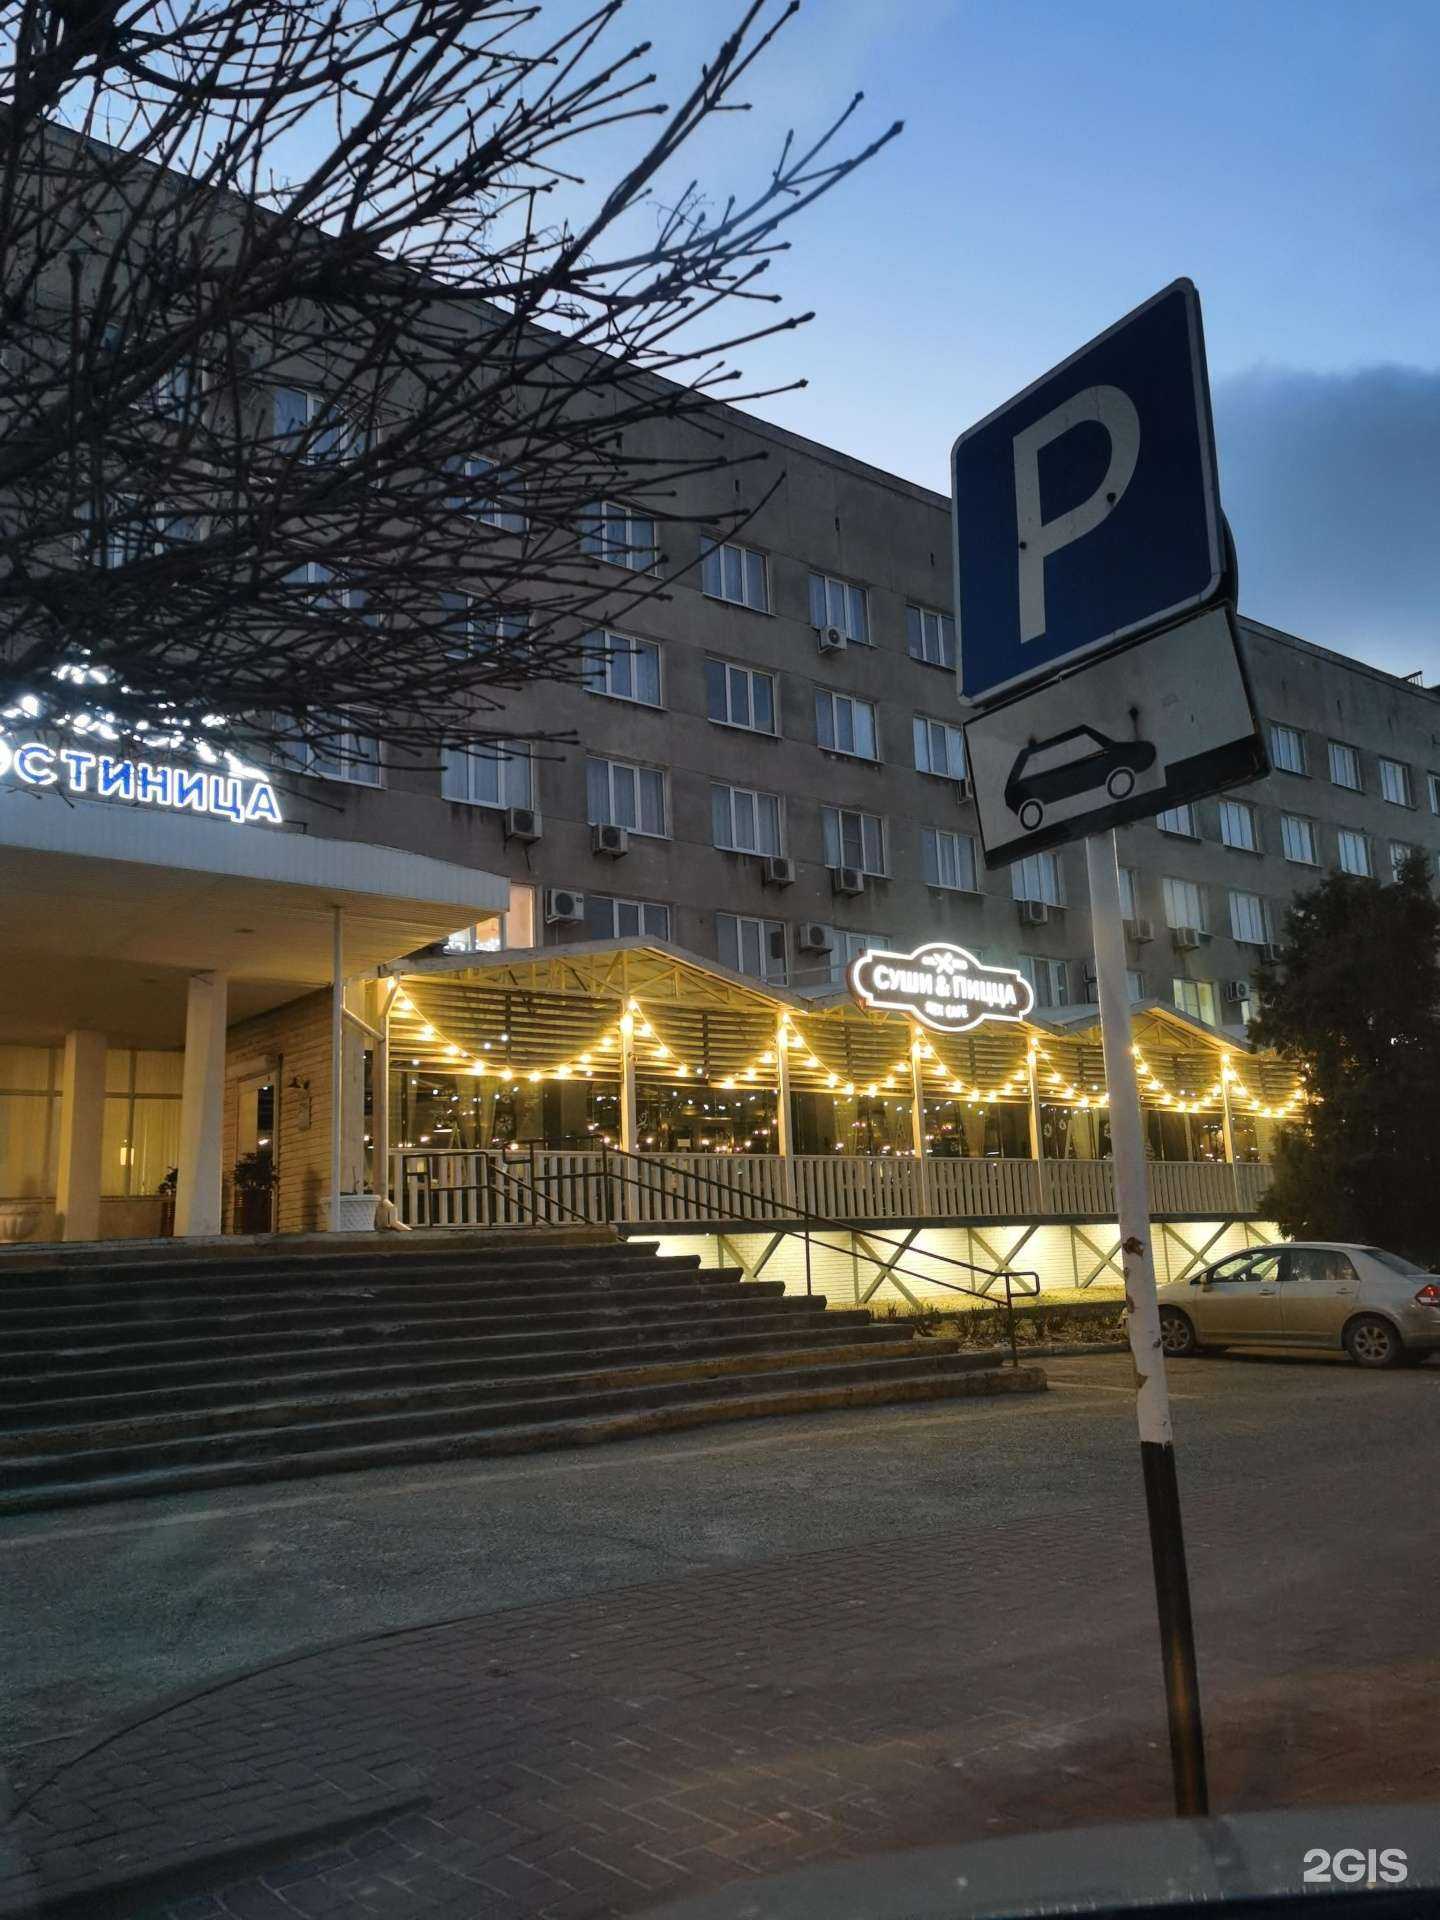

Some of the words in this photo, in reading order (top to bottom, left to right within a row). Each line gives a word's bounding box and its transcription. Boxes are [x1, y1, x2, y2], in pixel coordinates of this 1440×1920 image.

[1013, 384, 1140, 644] P
[0, 740, 282, 823] СТИНИЦА
[935, 974, 950, 997] &
